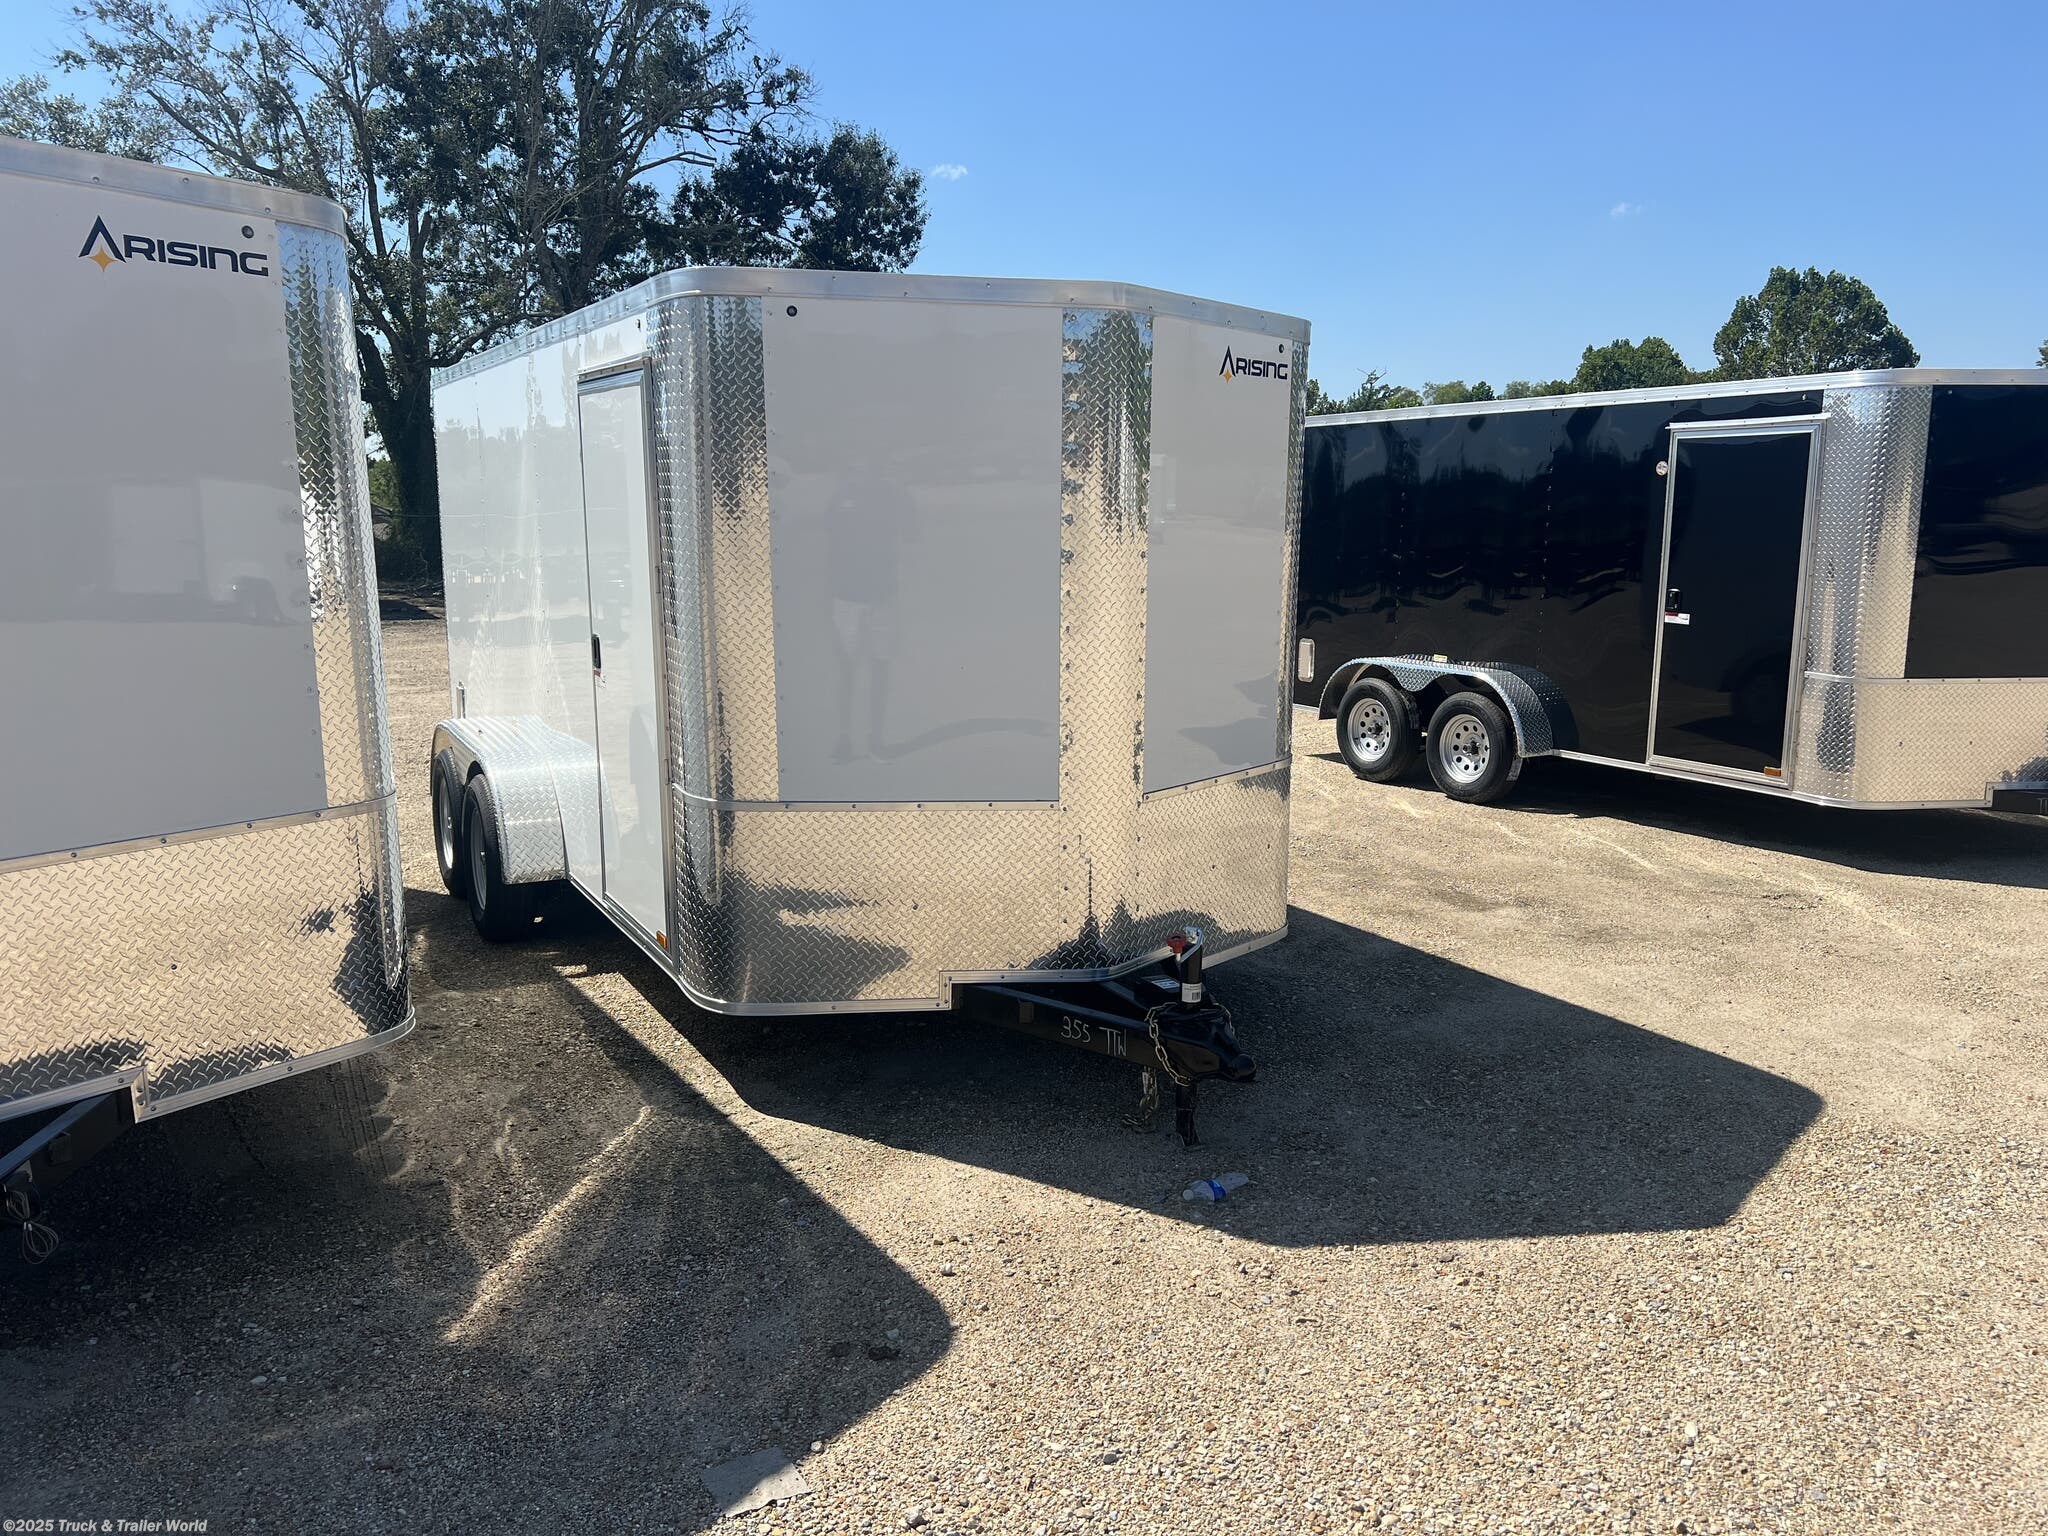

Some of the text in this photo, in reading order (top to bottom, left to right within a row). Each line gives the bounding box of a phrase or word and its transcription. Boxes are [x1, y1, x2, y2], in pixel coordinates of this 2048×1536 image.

[78, 215, 269, 277] ARISING
[1219, 345, 1288, 380] ARISING
[1061, 1015, 1091, 1043] 355
